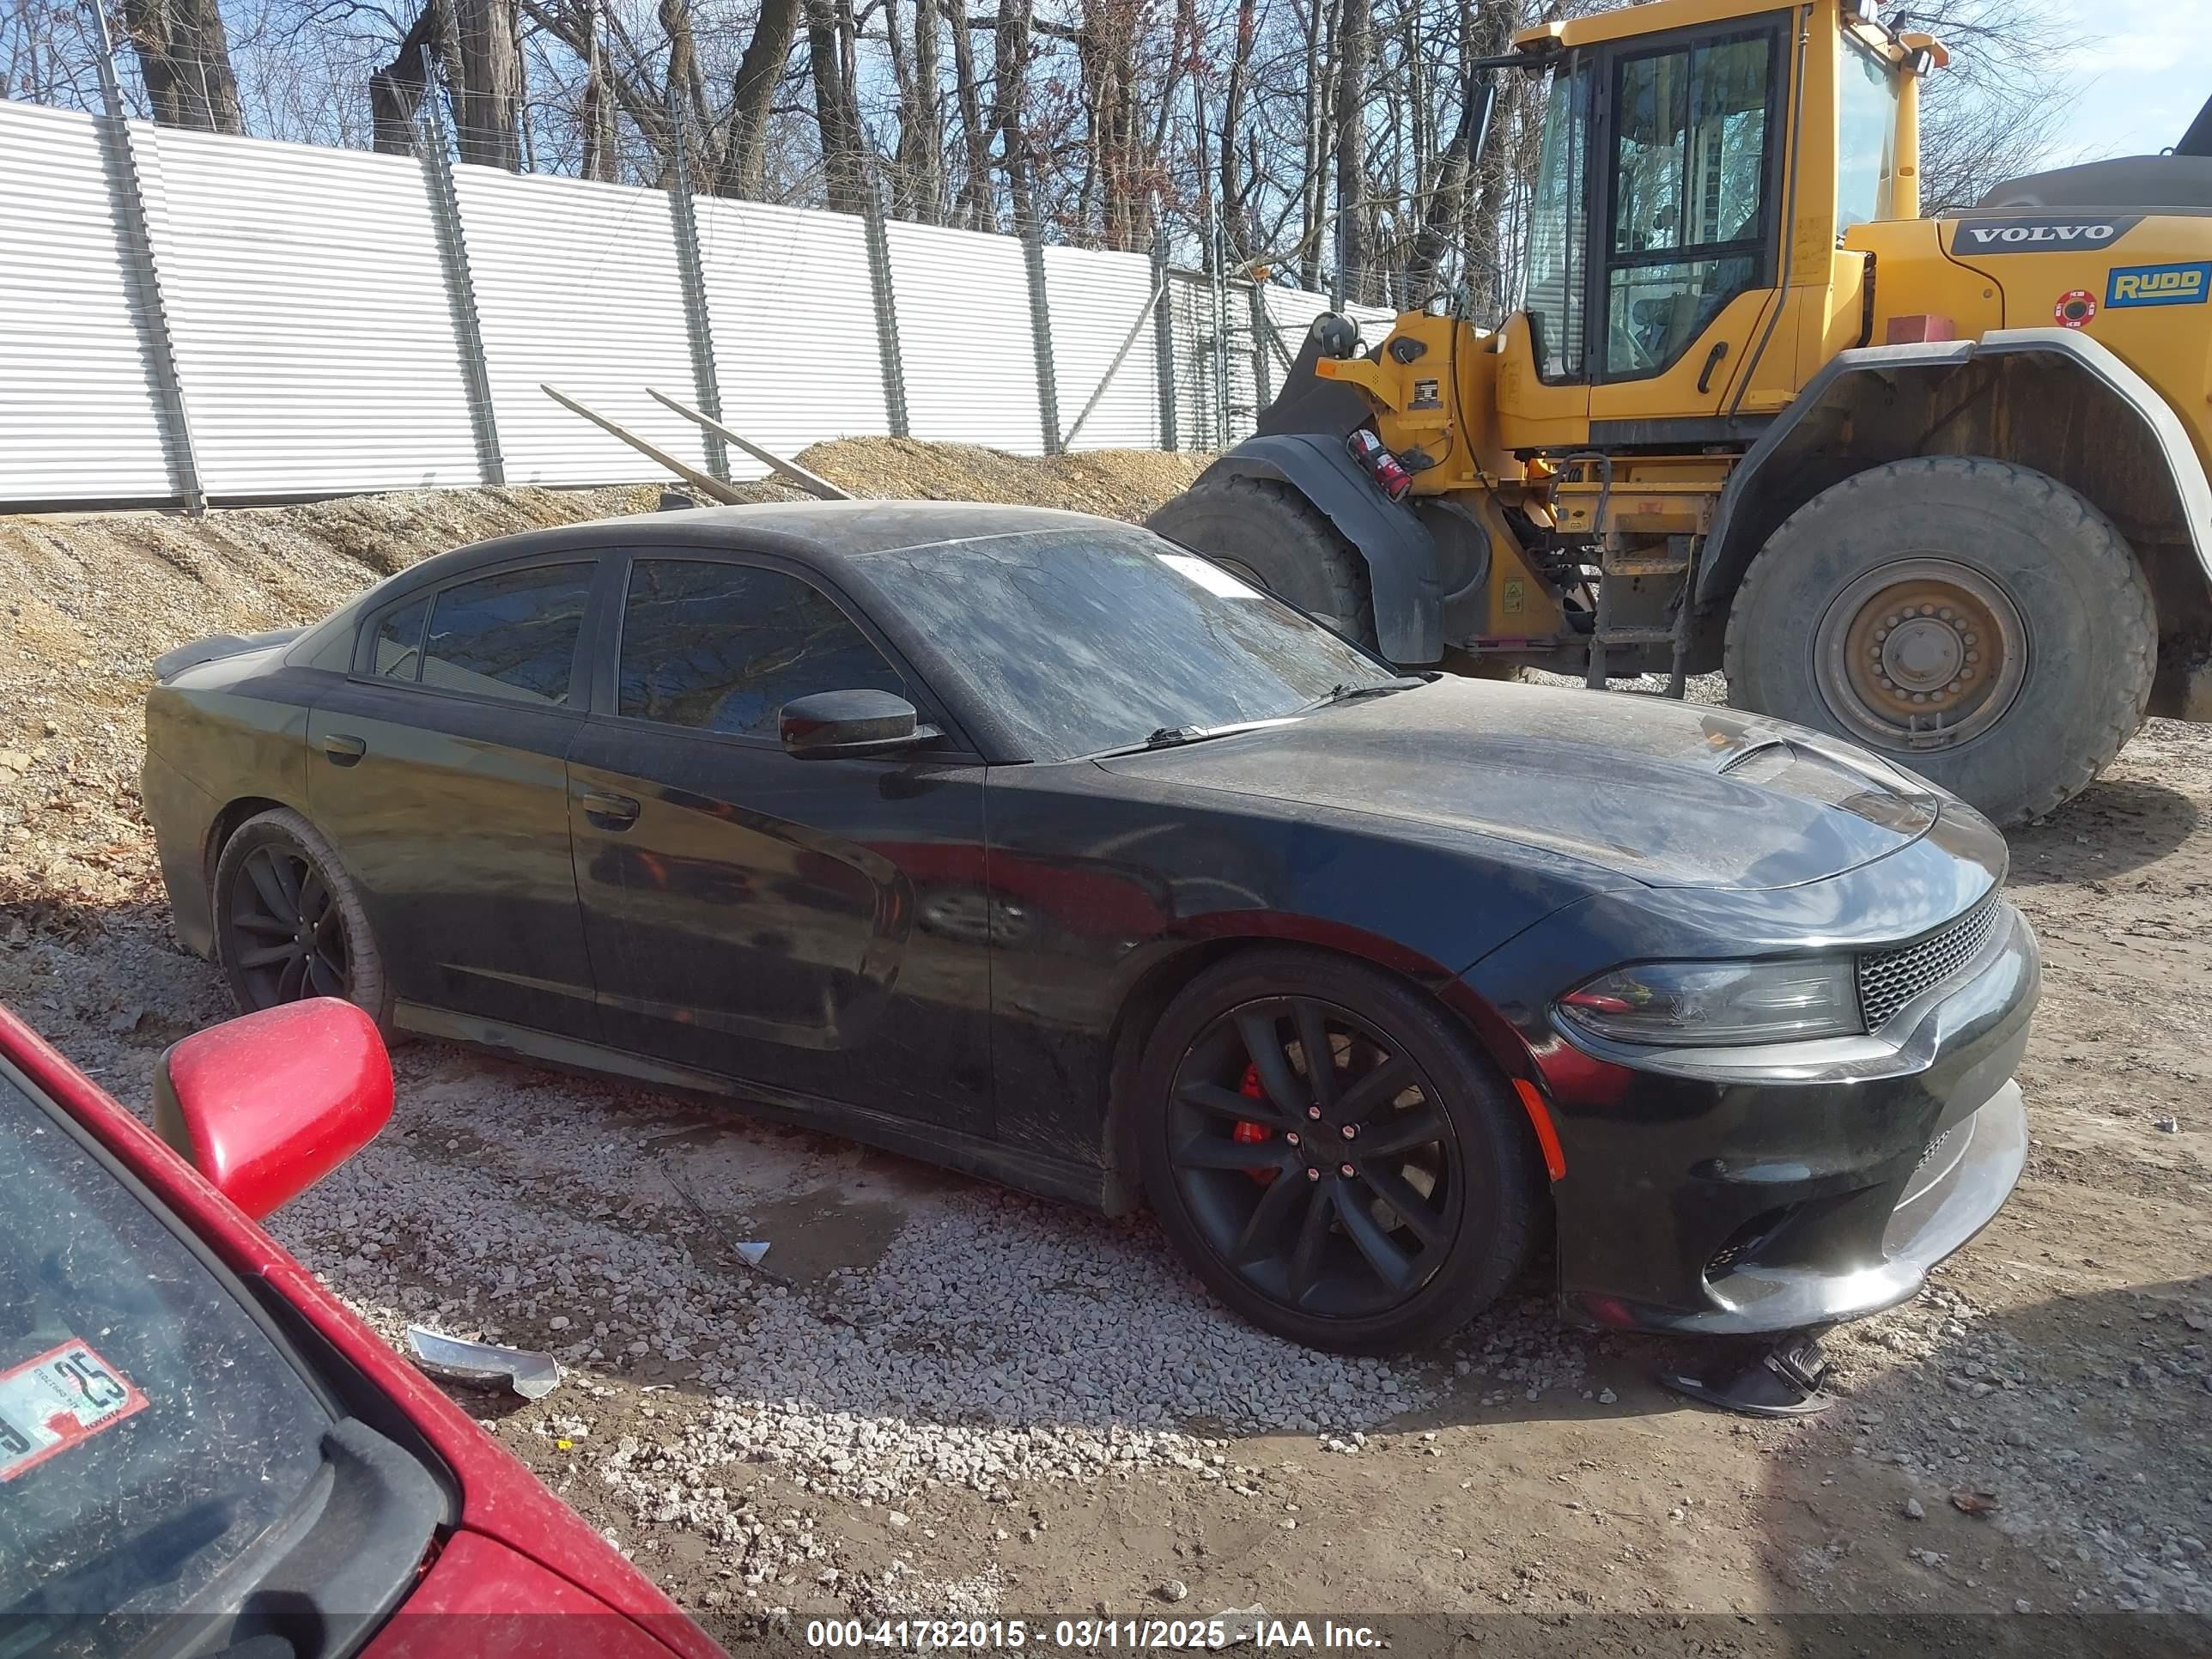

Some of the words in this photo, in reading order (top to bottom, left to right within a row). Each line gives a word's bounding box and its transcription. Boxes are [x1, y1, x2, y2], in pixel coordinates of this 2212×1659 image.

[1970, 225, 2114, 243] VOLVO
[2114, 270, 2203, 300] RUDD
[54, 1352, 125, 1407] 25
[85, 1408, 124, 1431] TOYOTA
